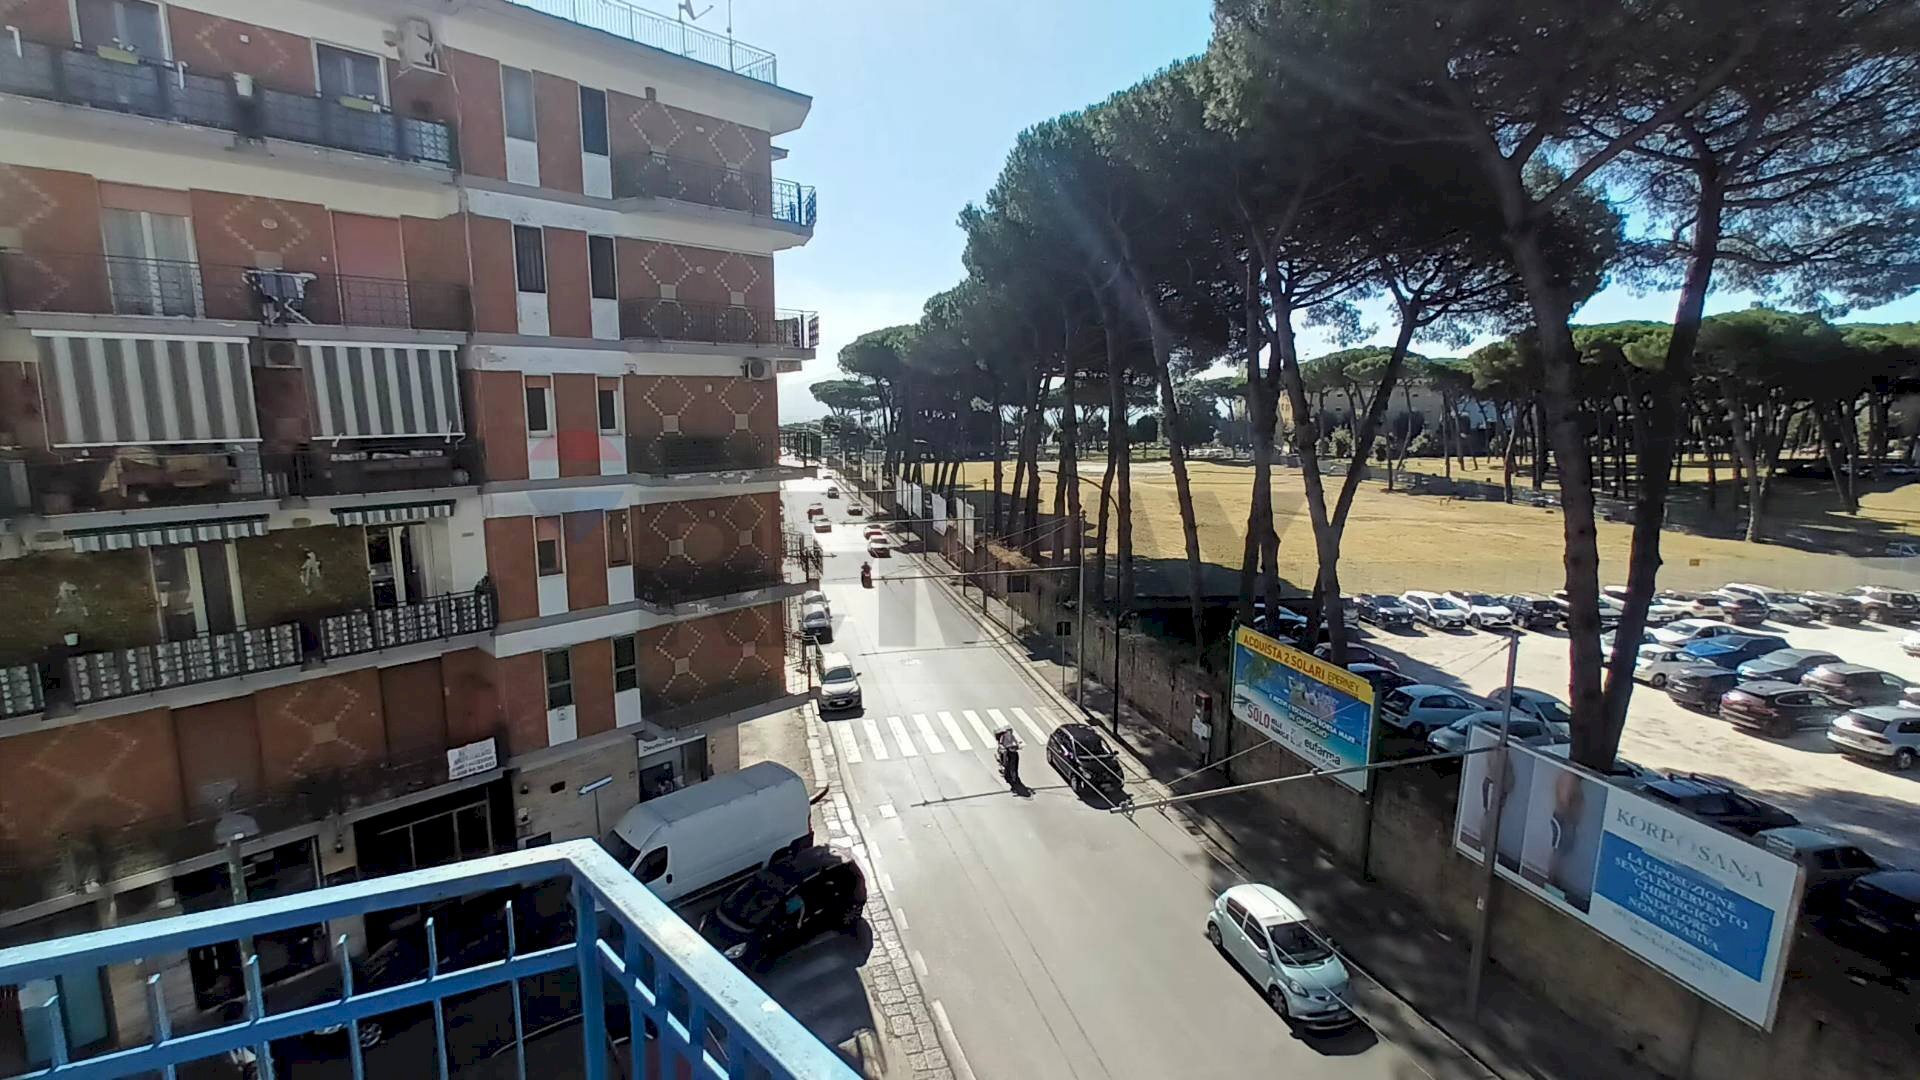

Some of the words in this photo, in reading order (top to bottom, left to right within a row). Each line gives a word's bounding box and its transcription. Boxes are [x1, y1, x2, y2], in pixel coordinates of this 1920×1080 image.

[1243, 634, 1283, 661] ACQUISTA
[1284, 652, 1290, 664] 2
[1291, 656, 1326, 679] SOLARI
[1247, 703, 1270, 729] SOLO
[1304, 738, 1341, 765] eufarma
[1615, 856, 1654, 884] SENZA
[1656, 877, 1749, 930] INTERVENTO
[1627, 851, 1642, 867] LA
[1645, 859, 1737, 911] LIPOSUZIONE
[1634, 878, 1721, 927] CHIRURGICO
[1628, 895, 1657, 918] NON
[1660, 913, 1720, 953] INVASIVA
[1639, 890, 1710, 933] INDOLORE
